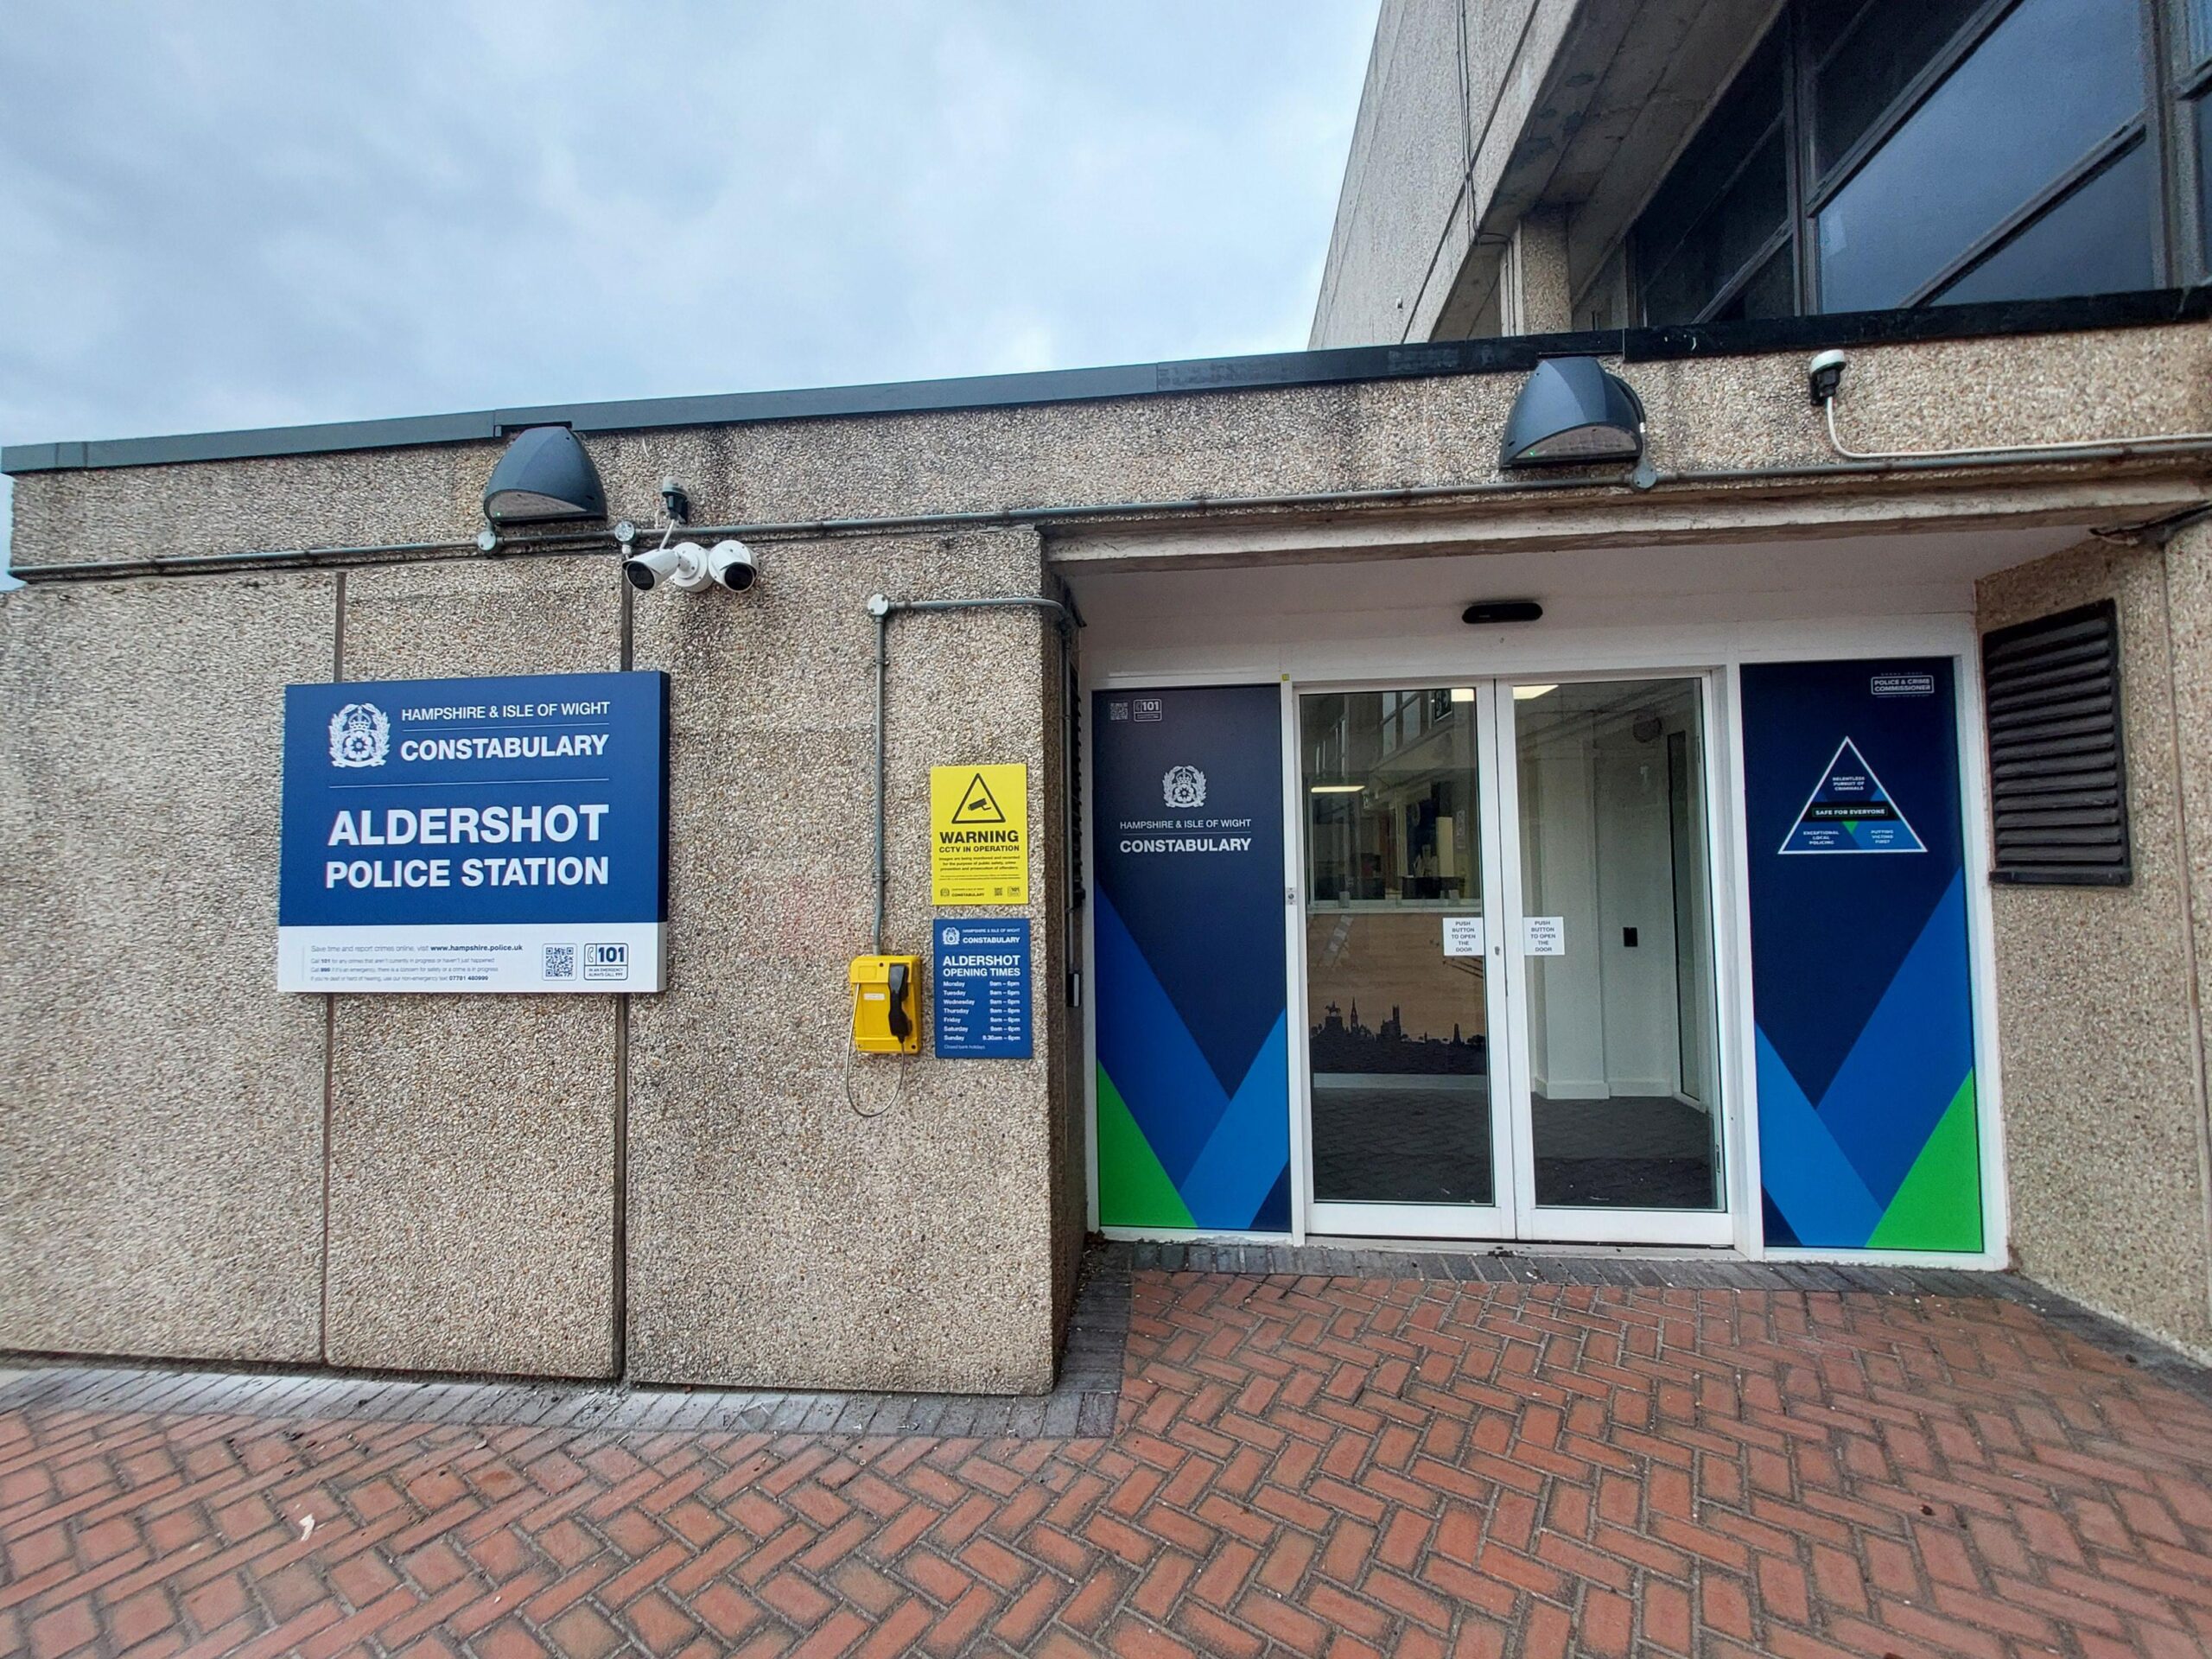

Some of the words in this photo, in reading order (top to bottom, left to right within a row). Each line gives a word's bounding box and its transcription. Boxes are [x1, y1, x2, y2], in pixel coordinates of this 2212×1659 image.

[401, 705, 486, 722] HAMPSHIRE
[489, 705, 499, 719] &
[502, 704, 533, 718] ISLE
[537, 703, 557, 717] OF
[561, 702, 610, 715] WIGHT
[1142, 702, 1159, 710] 101
[401, 734, 609, 761] CONSTABULARY
[327, 804, 609, 847] ALDERSHOT
[1119, 821, 1173, 830] HAMPSHIRE
[1175, 820, 1183, 829] &
[1184, 820, 1204, 829] ISLE
[1205, 819, 1218, 828] OF
[1220, 818, 1251, 828] WIGHT
[940, 830, 1019, 843] WARNING
[1119, 837, 1252, 853] CONSTABULARY
[326, 860, 450, 888] POLICE
[461, 856, 608, 887] STATION
[599, 947, 625, 963] 101
[943, 956, 1020, 966] ALDERSHOT
[990, 968, 1020, 976] TIMES
